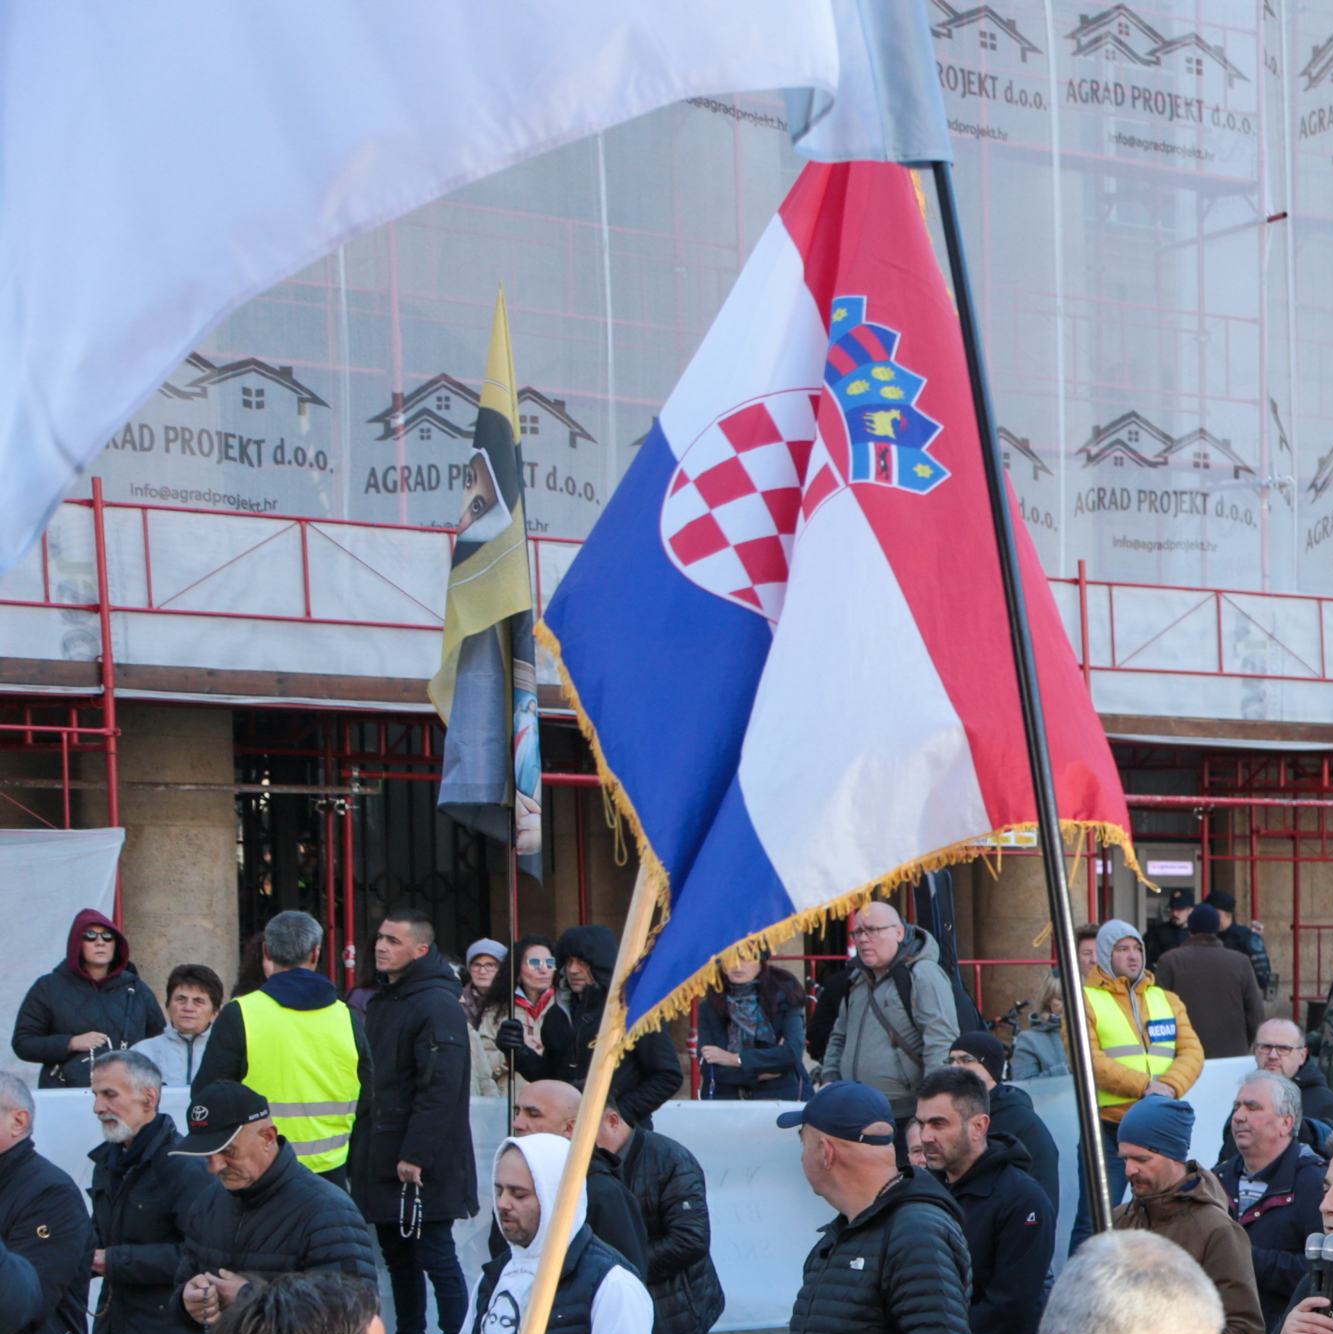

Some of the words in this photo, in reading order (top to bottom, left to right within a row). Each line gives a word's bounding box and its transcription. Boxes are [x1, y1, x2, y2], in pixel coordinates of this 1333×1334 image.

[937, 61, 998, 99] ROJEKT
[1004, 80, 1048, 111] d.o.o.
[1066, 78, 1125, 107] AGRAD
[1131, 85, 1204, 123] PROJEKT
[1211, 106, 1257, 136] d.o.o.
[105, 424, 155, 453] RAD
[164, 425, 266, 468] PROJEKT
[273, 437, 335, 474] d.o.o.
[364, 464, 441, 495] AGRAD
[546, 466, 600, 505] d.o.o.
[1074, 487, 1132, 517] AGRAD
[1137, 490, 1210, 518] PROJEKT
[1215, 496, 1258, 528] d.o.o.
[1148, 1024, 1176, 1037] REDAR
